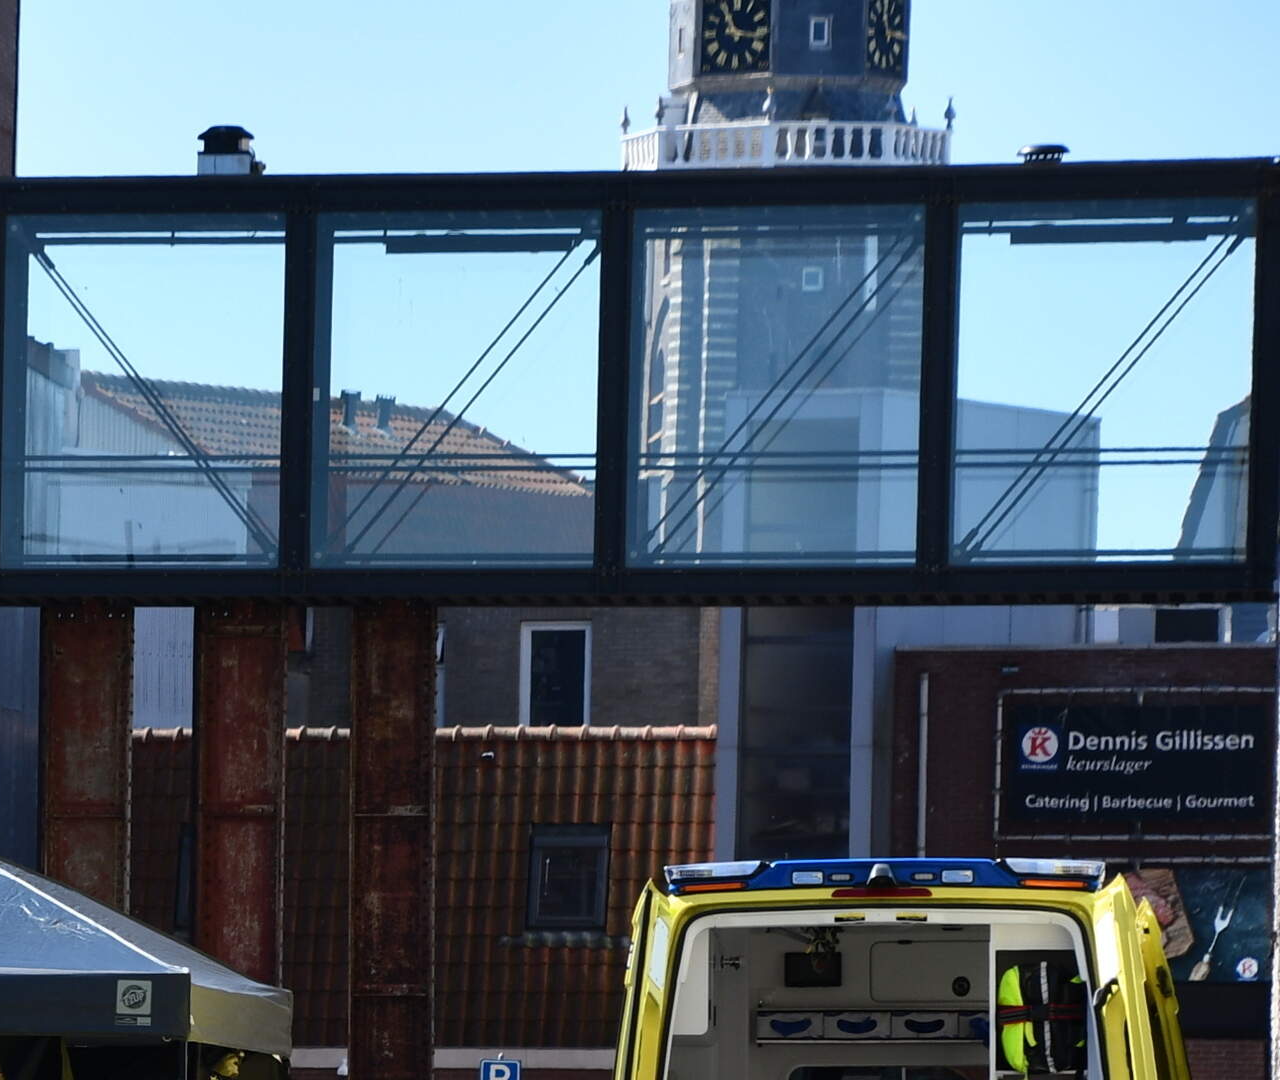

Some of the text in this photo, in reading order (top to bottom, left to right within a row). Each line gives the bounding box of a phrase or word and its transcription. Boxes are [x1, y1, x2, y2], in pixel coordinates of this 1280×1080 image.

[1068, 731, 1254, 750] Dennis Gillissen
[1066, 755, 1152, 774] keurslager
[1025, 794, 1089, 812] Catering
[1102, 795, 1172, 809] Barbecue
[1185, 794, 1255, 809] Gourmet
